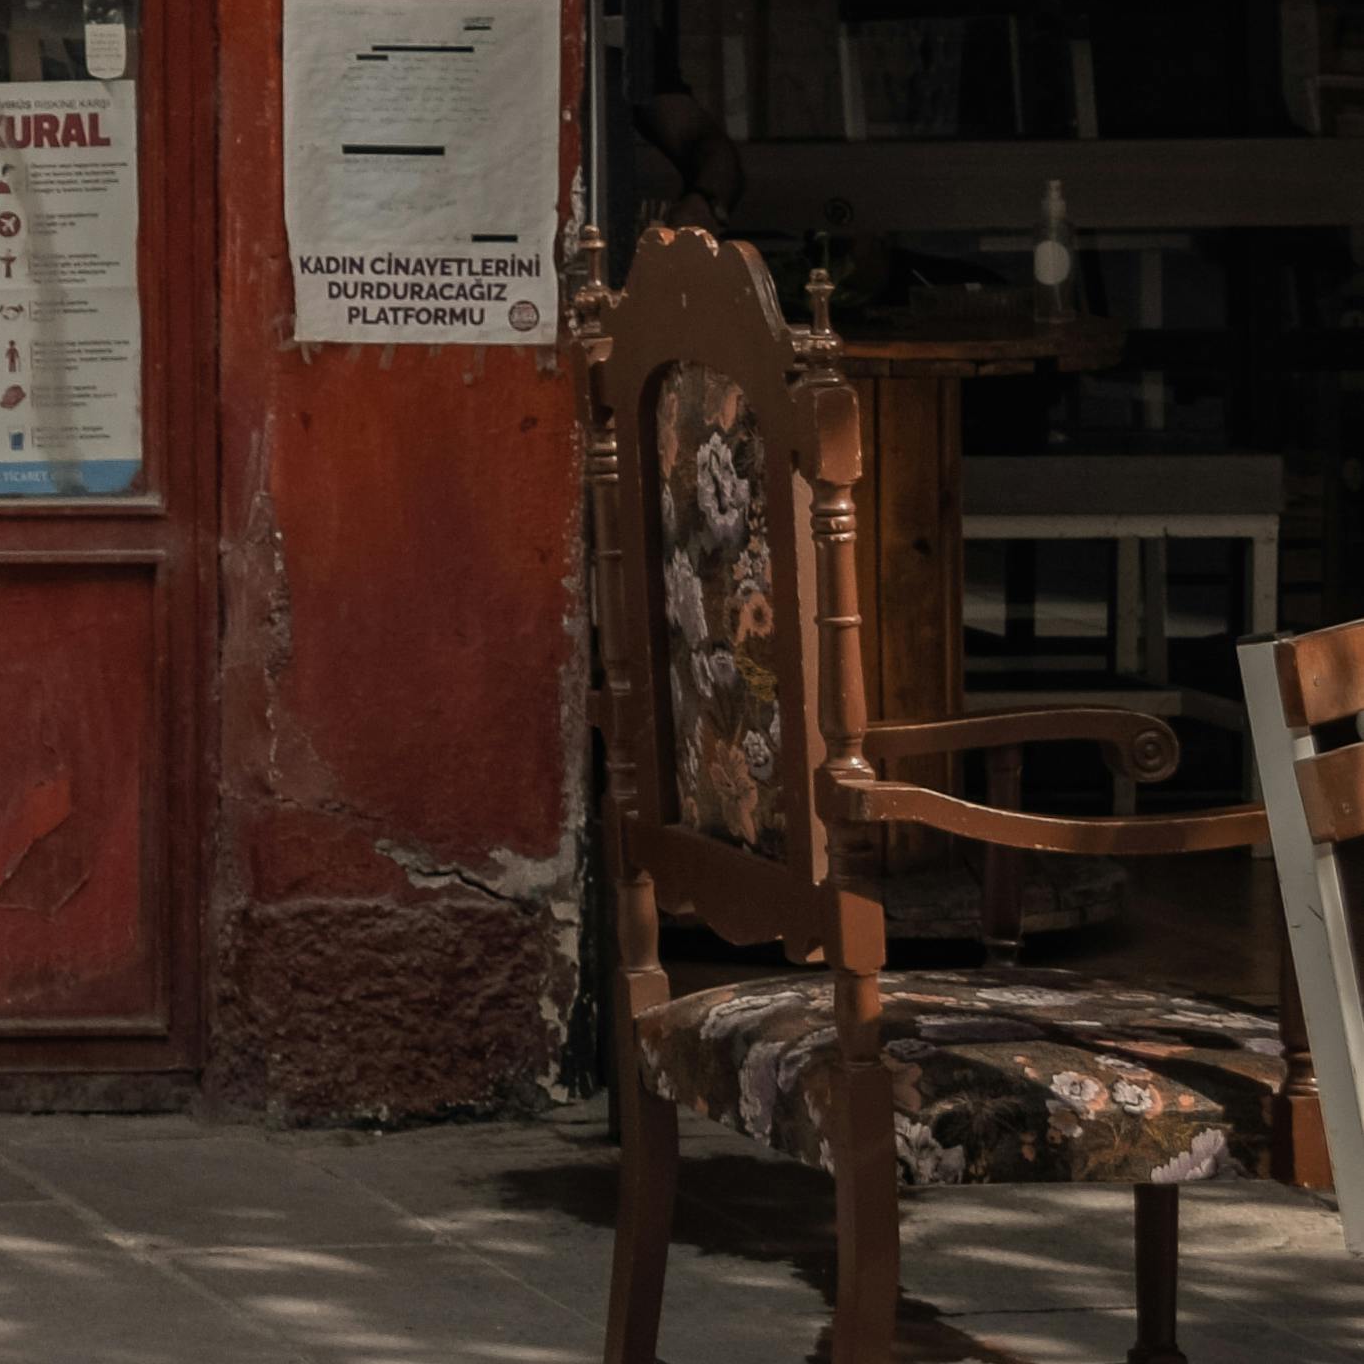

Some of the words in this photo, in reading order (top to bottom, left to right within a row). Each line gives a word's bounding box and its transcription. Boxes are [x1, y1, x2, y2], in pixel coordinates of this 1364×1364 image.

[299, 256, 364, 275] KADIN
[369, 252, 541, 277] CİNAYETLERİNİ
[327, 278, 507, 302] DURDURACAĞIZ
[347, 306, 485, 326] PLATFORMU
